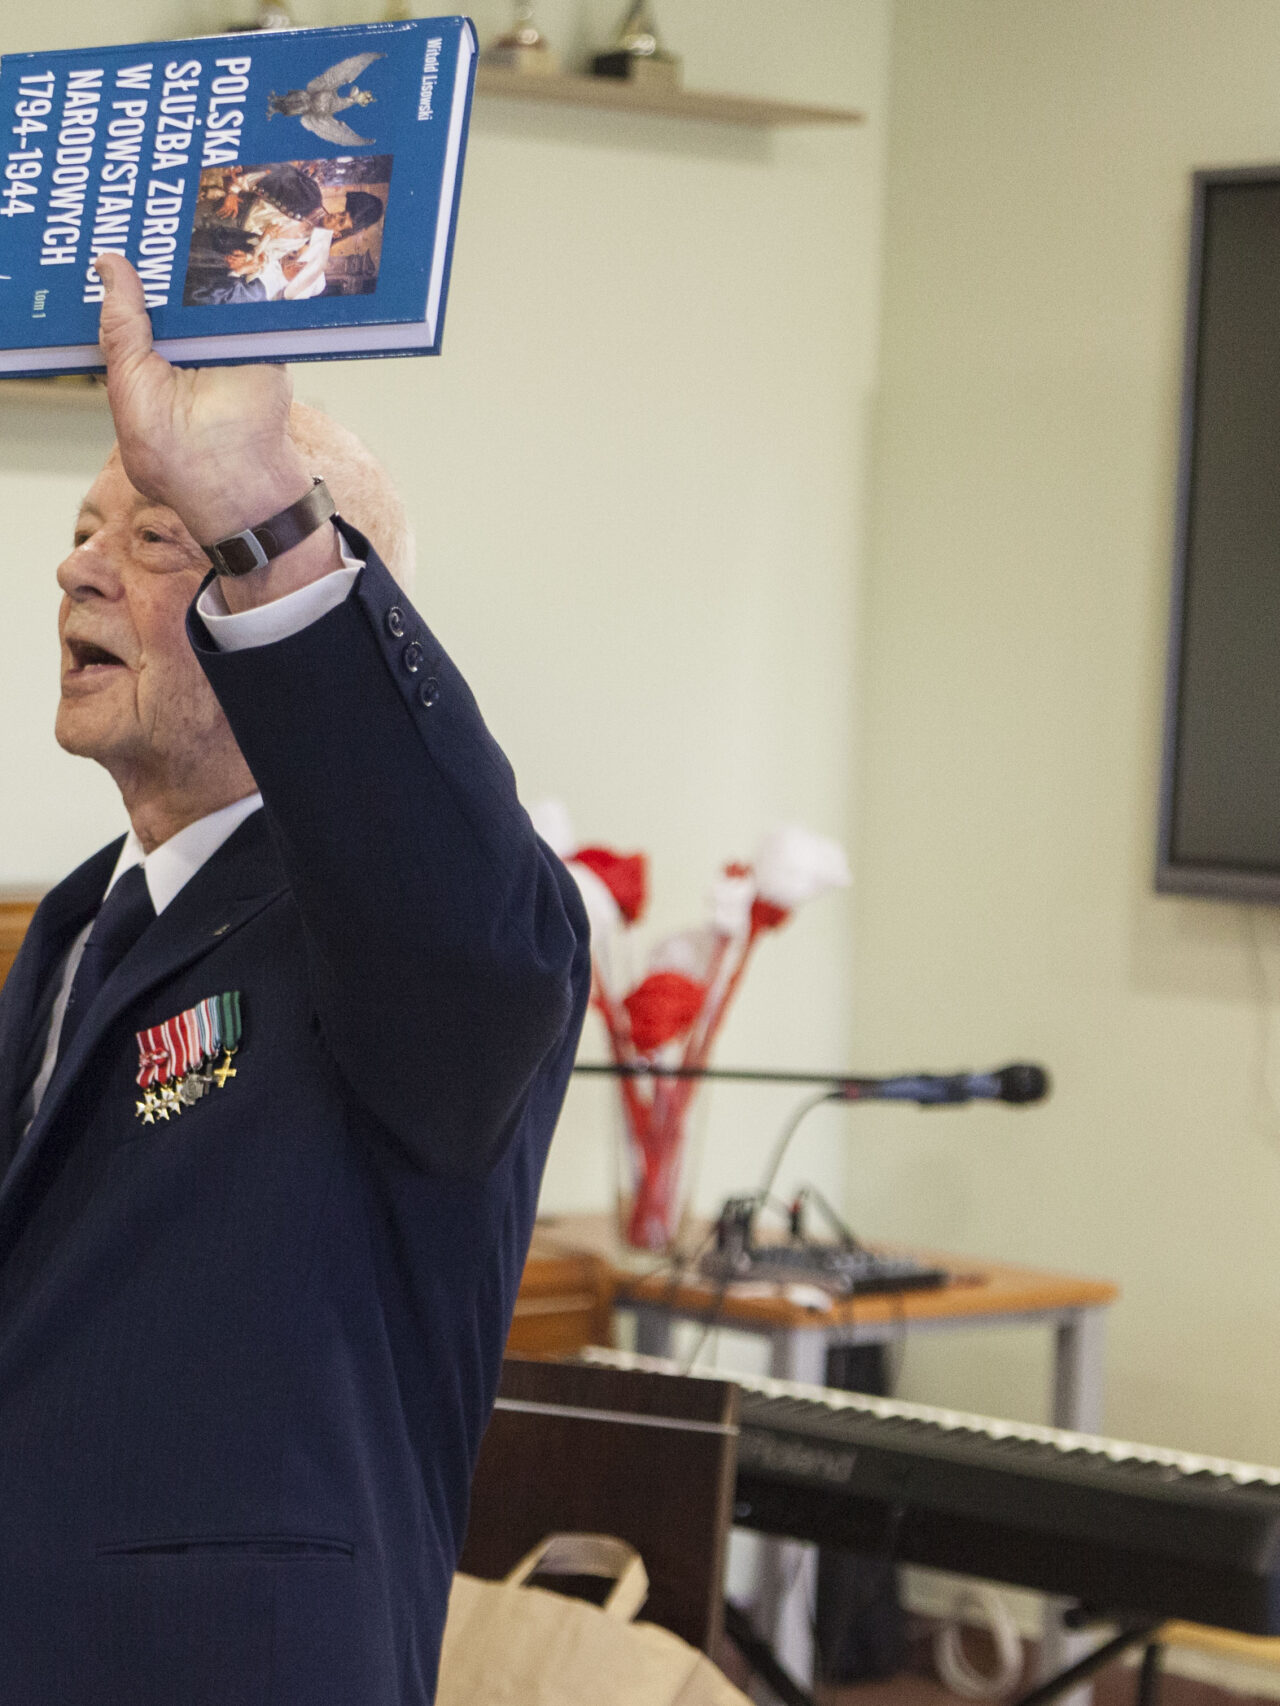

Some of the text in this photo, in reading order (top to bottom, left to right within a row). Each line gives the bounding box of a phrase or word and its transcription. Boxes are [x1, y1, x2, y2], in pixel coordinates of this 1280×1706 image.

[115, 63, 154, 90] W
[201, 56, 252, 167] POLSKA
[417, 37, 443, 121] Witold Lisowski
[0, 70, 56, 218] 1794-1944
[40, 68, 105, 266] NARODOWYCH
[137, 60, 202, 309] SŁUŻBA ZDROWIA
[33, 288, 50, 311] tom
